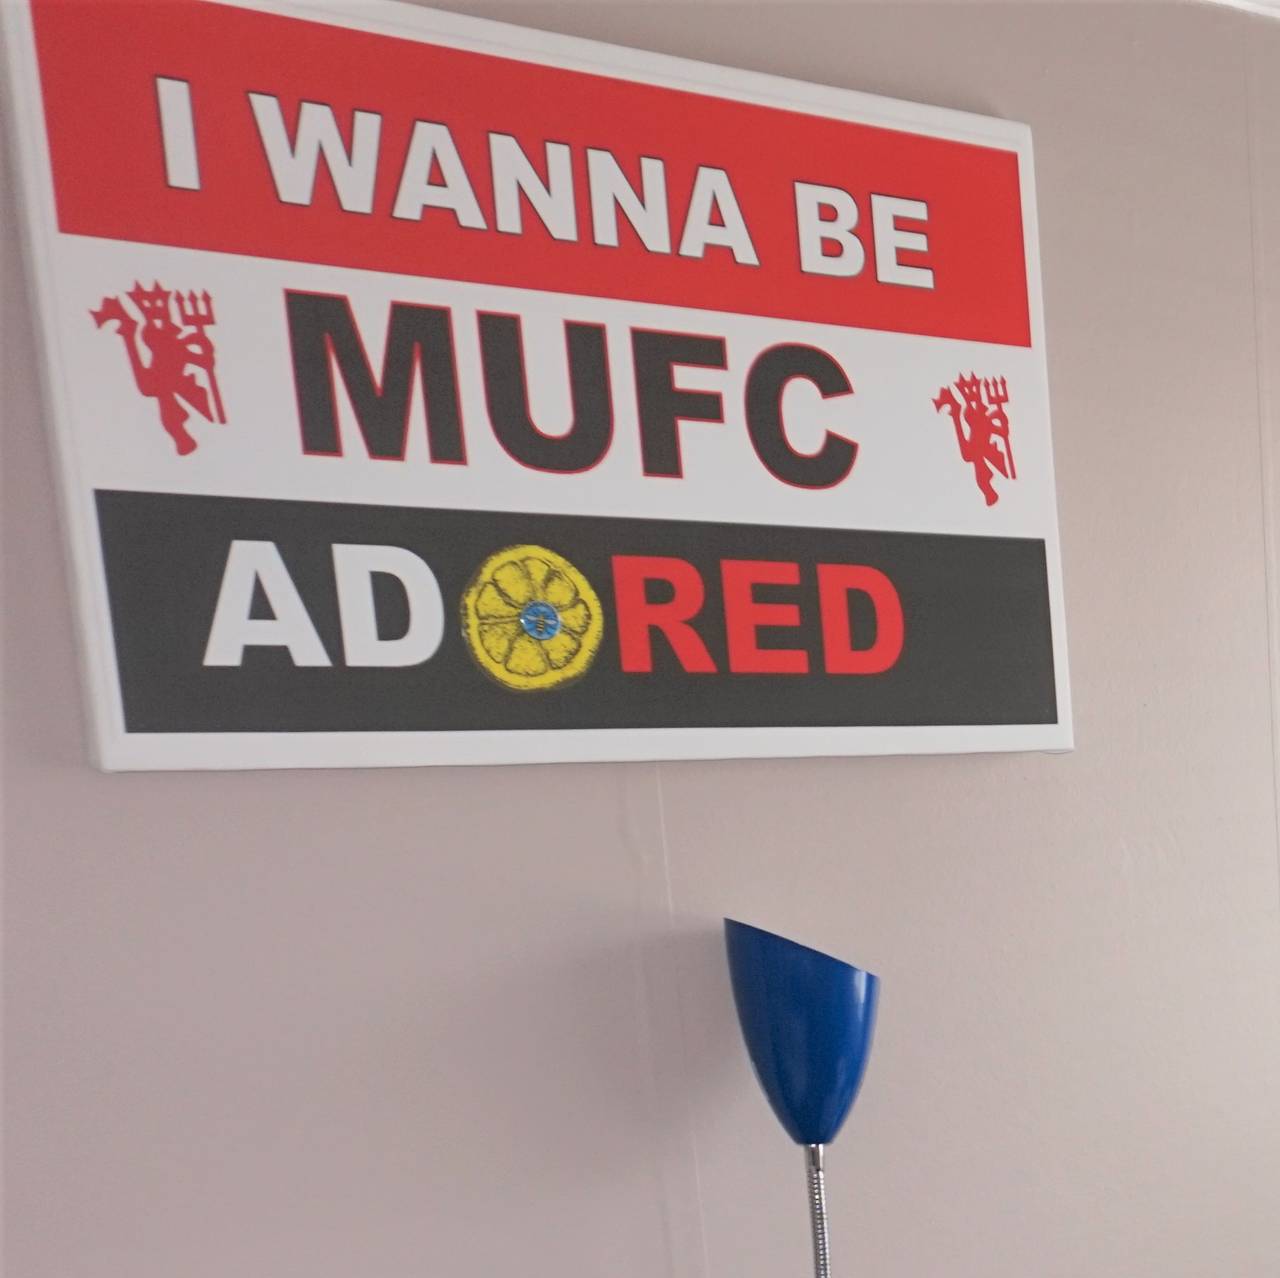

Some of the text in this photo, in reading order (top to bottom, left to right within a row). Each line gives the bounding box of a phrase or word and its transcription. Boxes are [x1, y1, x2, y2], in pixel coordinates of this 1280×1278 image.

[153, 76, 936, 290] I WANNA BE
[283, 287, 860, 490] MUFC
